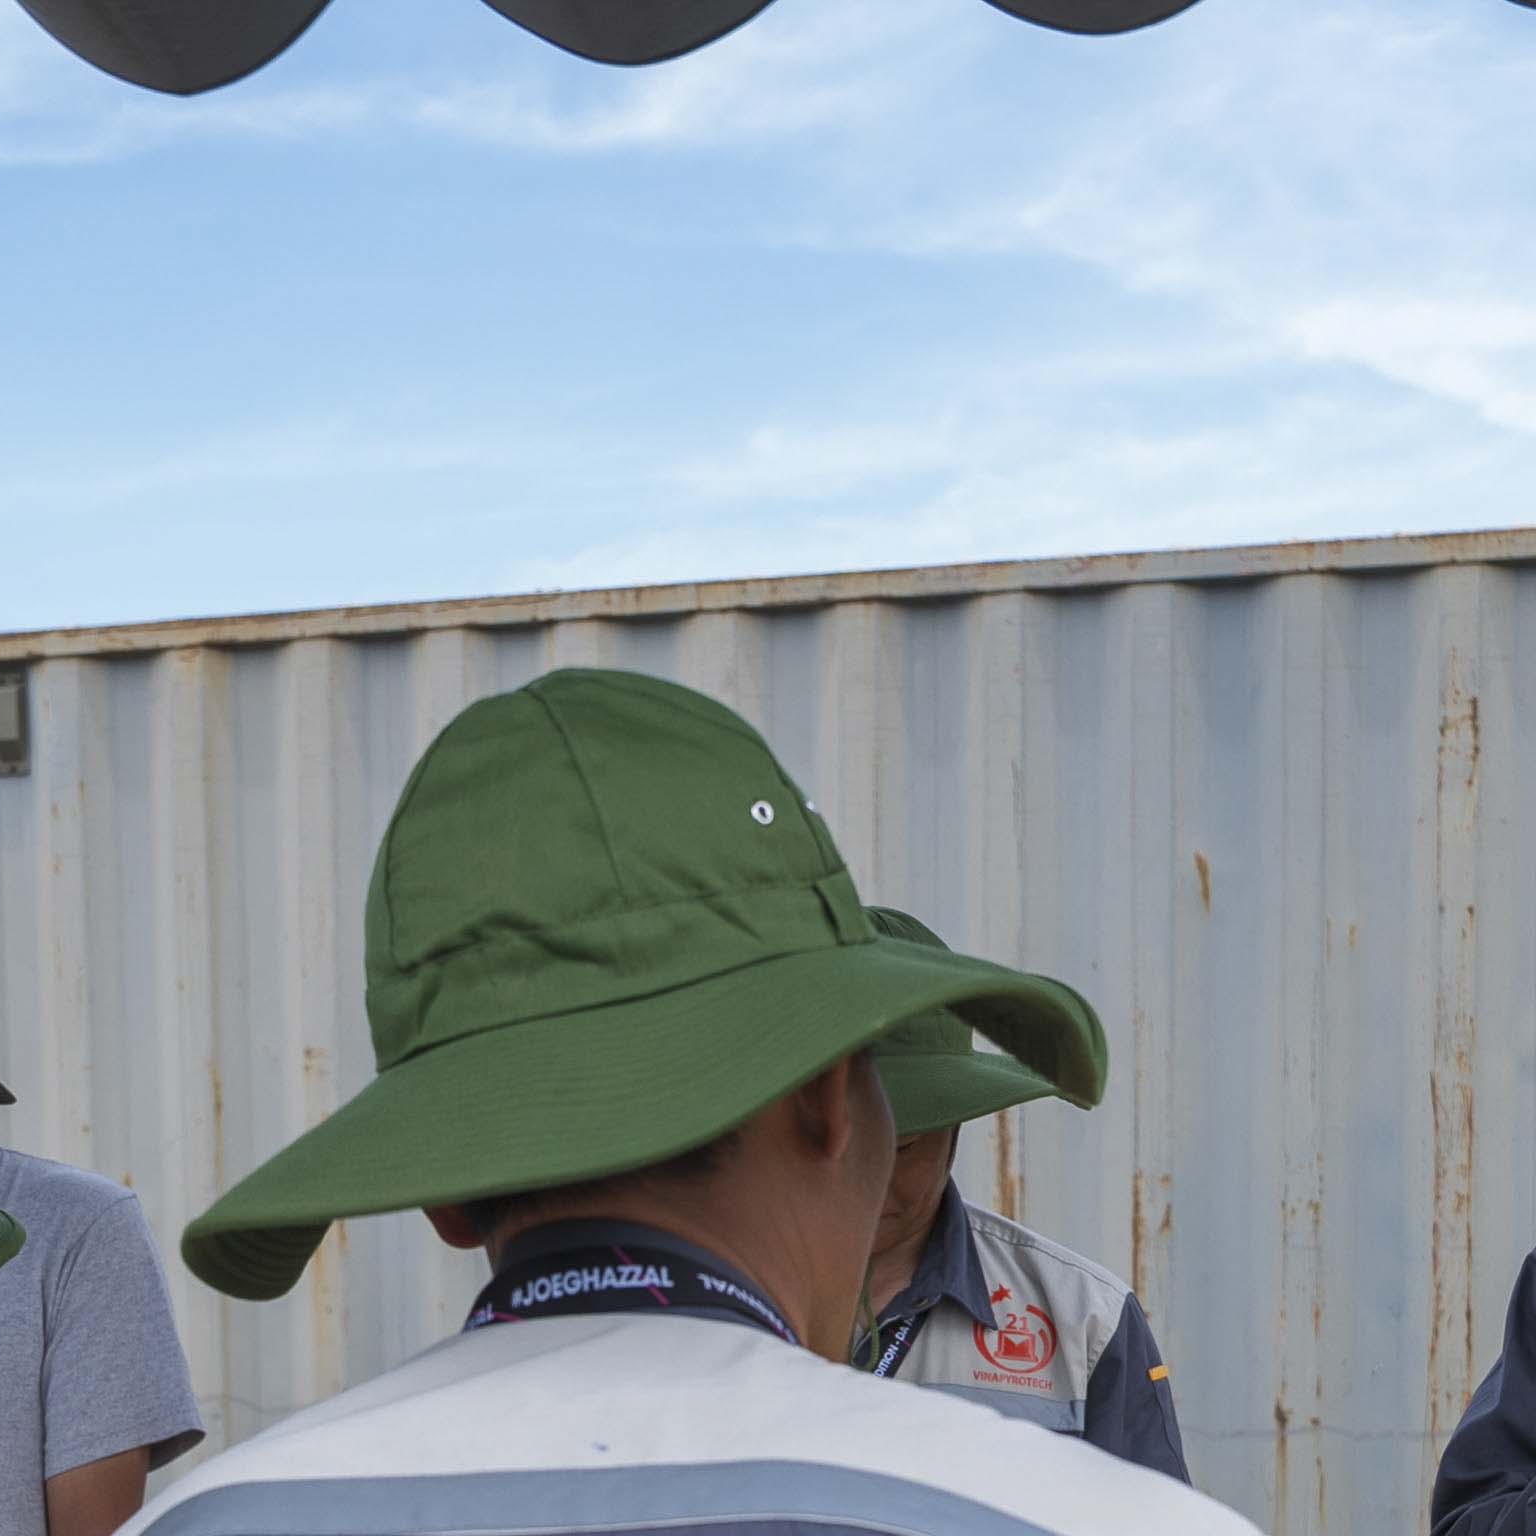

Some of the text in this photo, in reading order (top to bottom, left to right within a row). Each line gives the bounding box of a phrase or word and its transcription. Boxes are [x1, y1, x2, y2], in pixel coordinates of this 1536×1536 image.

[511, 1265, 675, 1308] #JOEGHAZZAL
[1006, 1313, 1029, 1332] 21
[874, 1343, 899, 1377] DITION
[972, 1370, 1053, 1391] VINAPYROTECH
